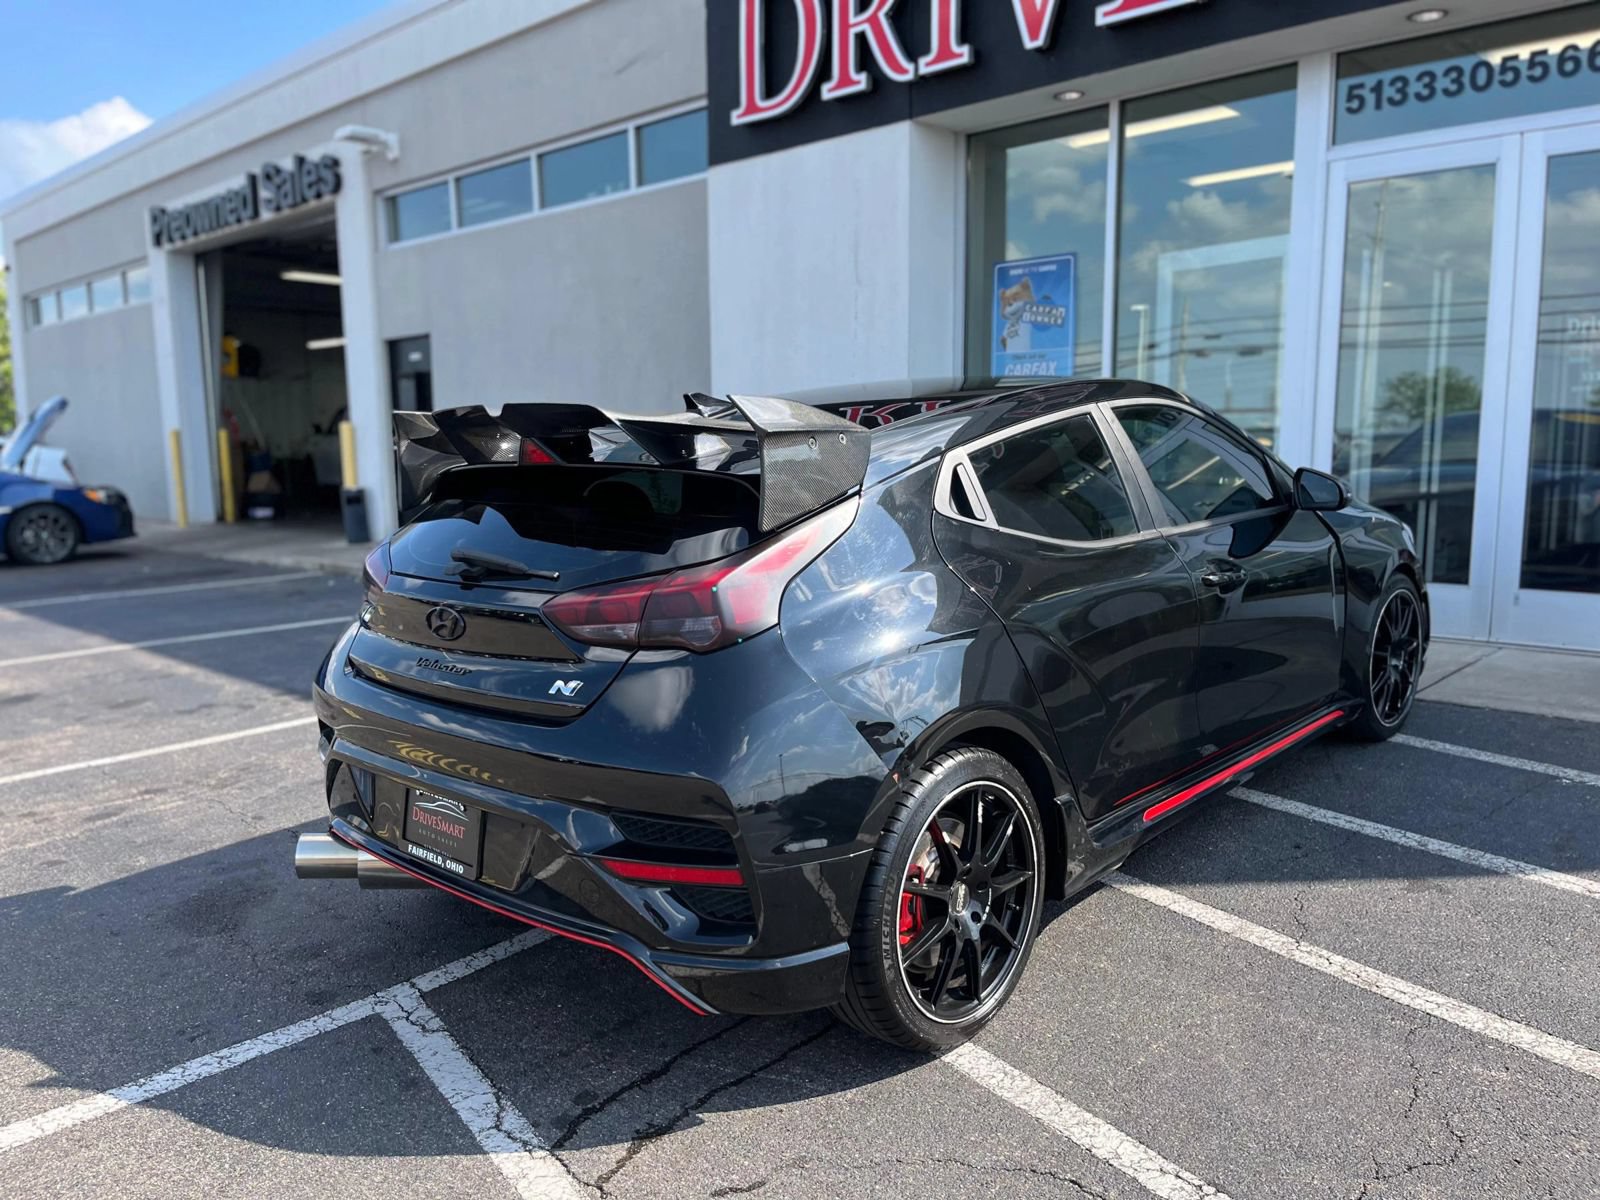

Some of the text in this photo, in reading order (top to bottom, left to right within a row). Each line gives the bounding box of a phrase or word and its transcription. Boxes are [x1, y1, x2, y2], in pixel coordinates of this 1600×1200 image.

[150, 153, 342, 247] Preowned Sales
[1004, 360, 1057, 376] CARFAX
[408, 844, 444, 868] FAIRFIELD,
[445, 859, 464, 874] OHIO
